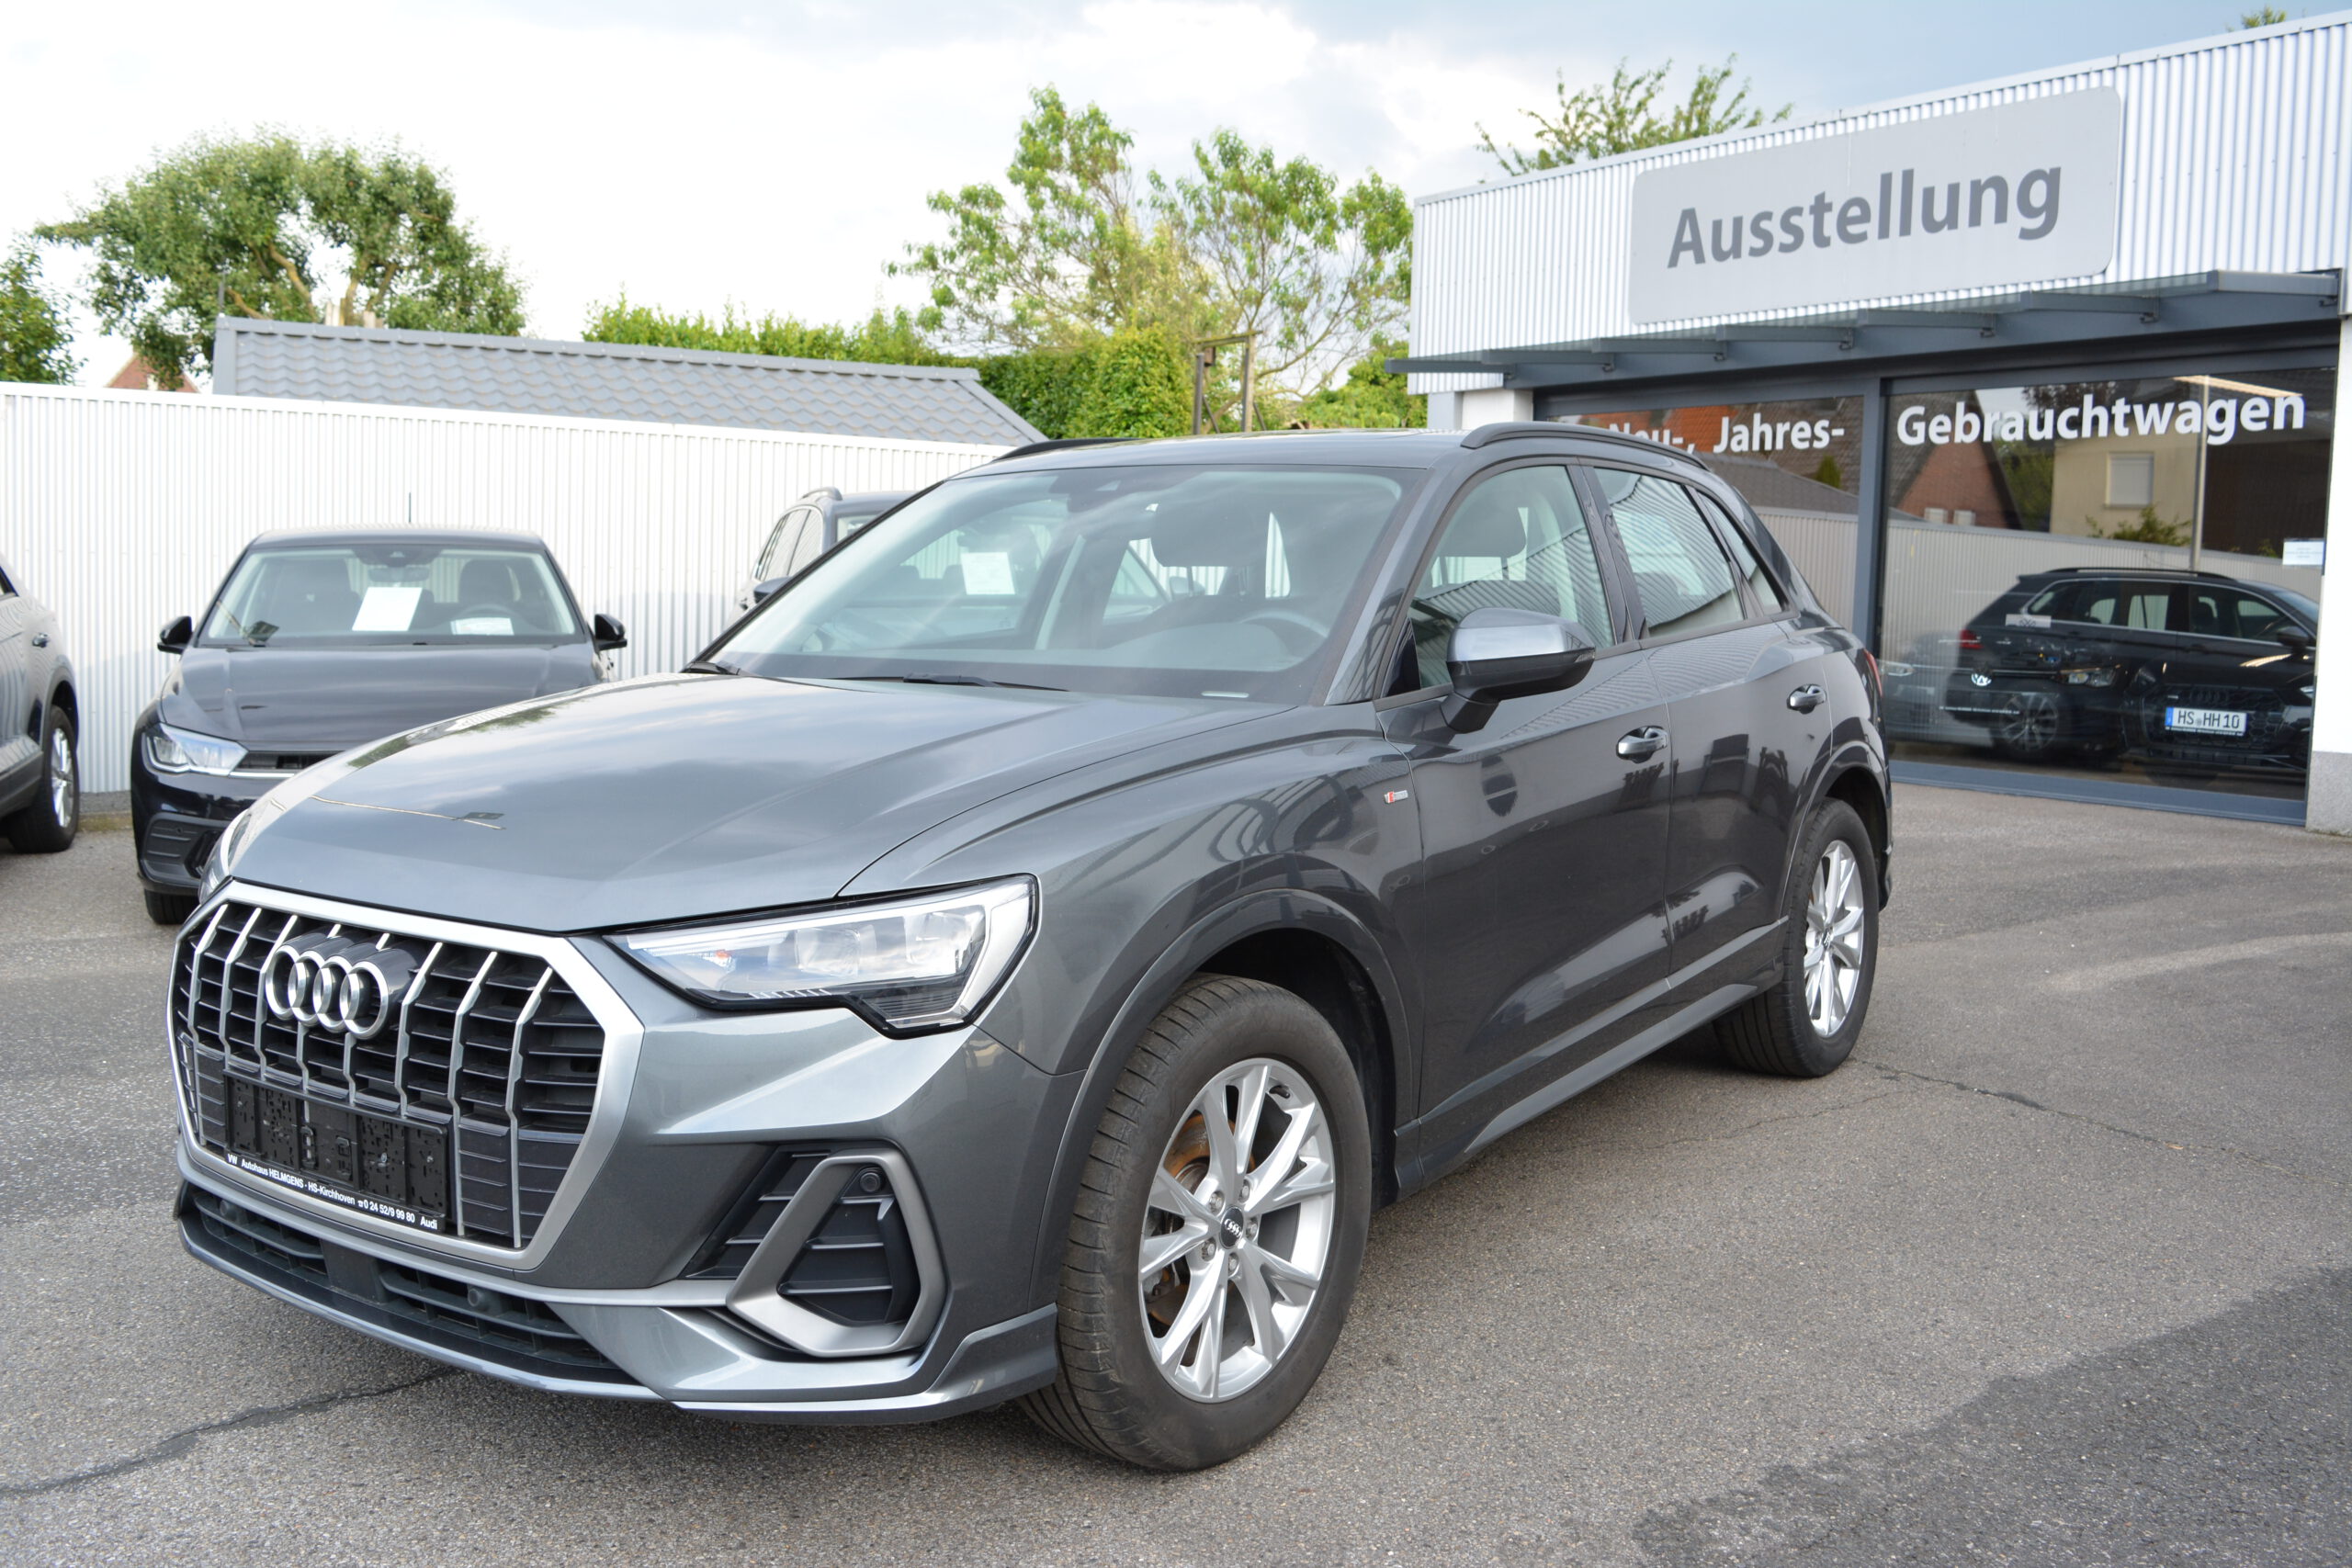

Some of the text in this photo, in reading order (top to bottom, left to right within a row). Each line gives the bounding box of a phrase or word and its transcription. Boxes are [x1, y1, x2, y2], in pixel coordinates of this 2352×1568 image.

[1667, 166, 2062, 269] Ausstellung
[1713, 412, 1845, 454] Jahres-
[1896, 393, 2305, 446] Gebrauchtwagen
[227, 1153, 238, 1165] VW
[241, 1158, 268, 1176] Autohaus
[268, 1168, 304, 1189] HELMGENS
[308, 1181, 356, 1206] HS-Kirchhoven
[369, 1201, 379, 1213] 24
[379, 1204, 395, 1217] 52/9
[395, 1208, 405, 1220] 99
[405, 1212, 415, 1224] 80
[420, 1215, 438, 1230] Audi
